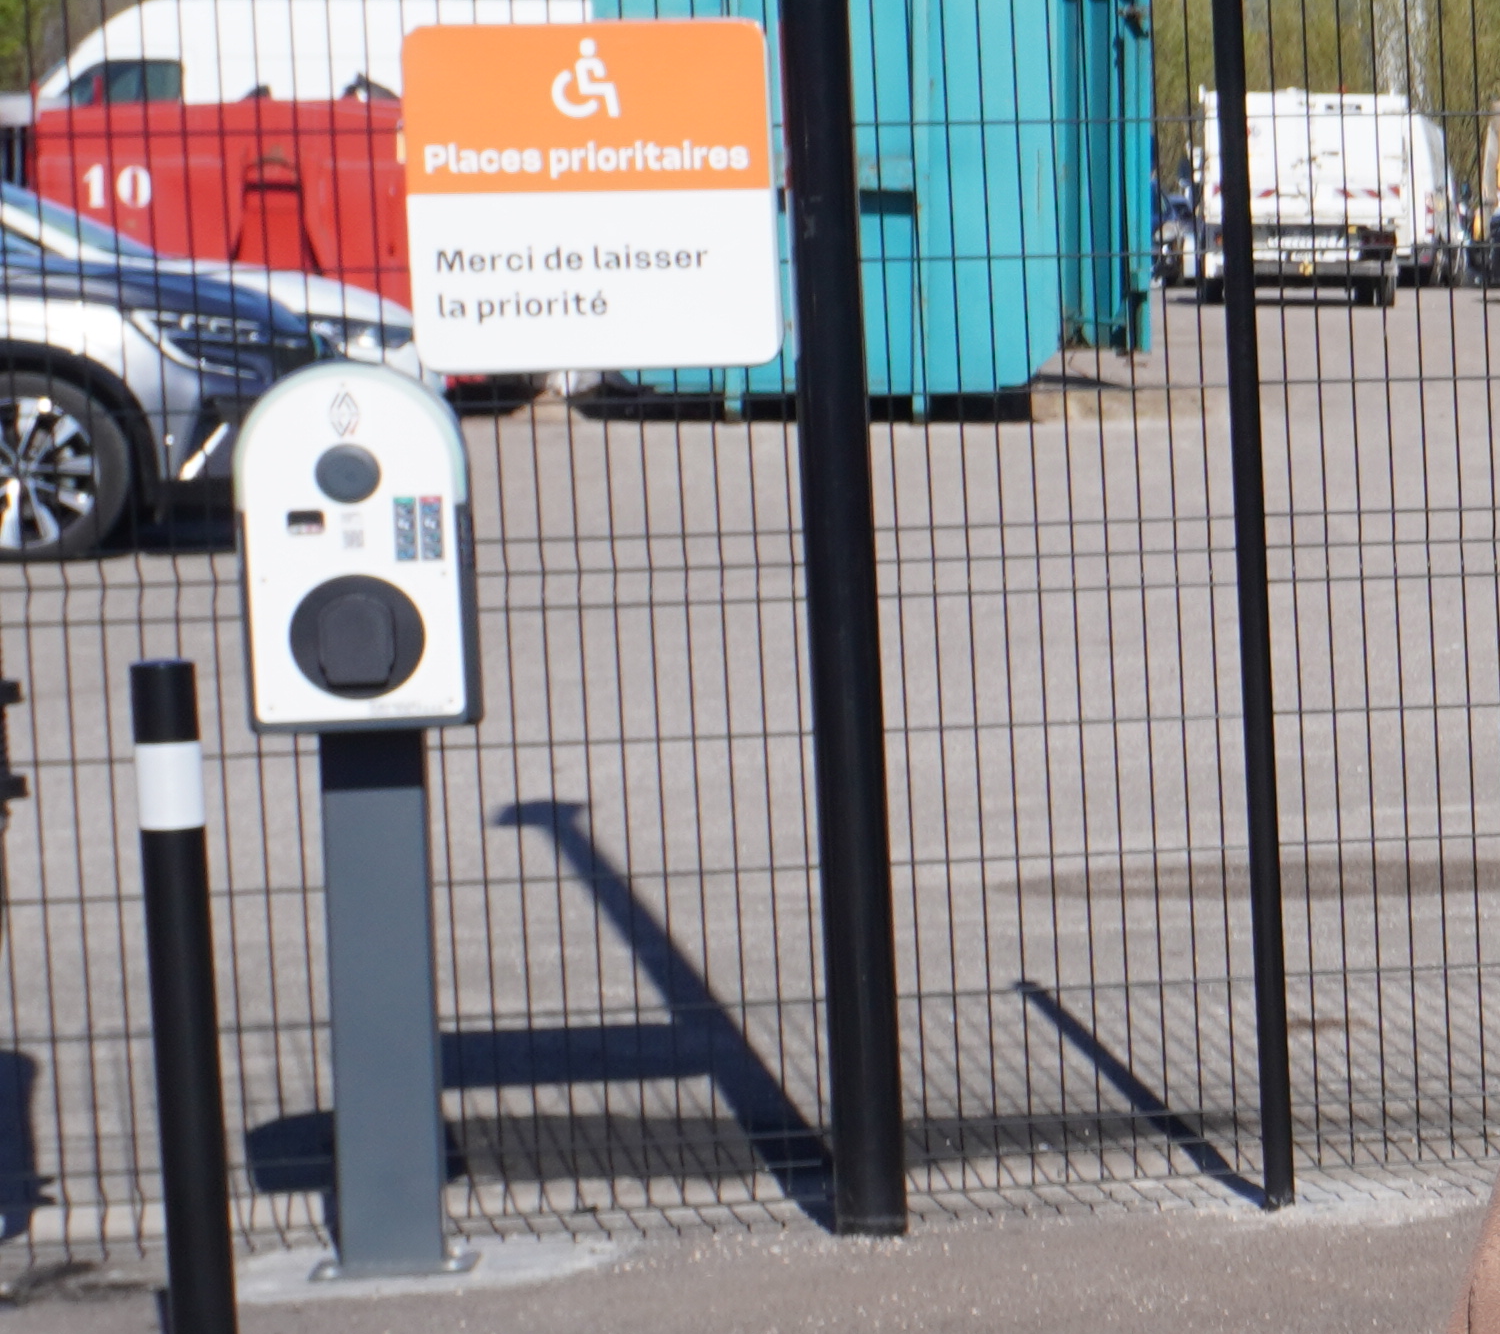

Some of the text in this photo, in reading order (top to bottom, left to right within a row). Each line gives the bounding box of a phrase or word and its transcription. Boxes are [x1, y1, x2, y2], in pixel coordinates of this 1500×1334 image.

[423, 140, 750, 180] Places prioritaires
[82, 163, 152, 209] 10
[436, 244, 710, 273] Merci de laisser
[438, 290, 609, 325] la priorité
